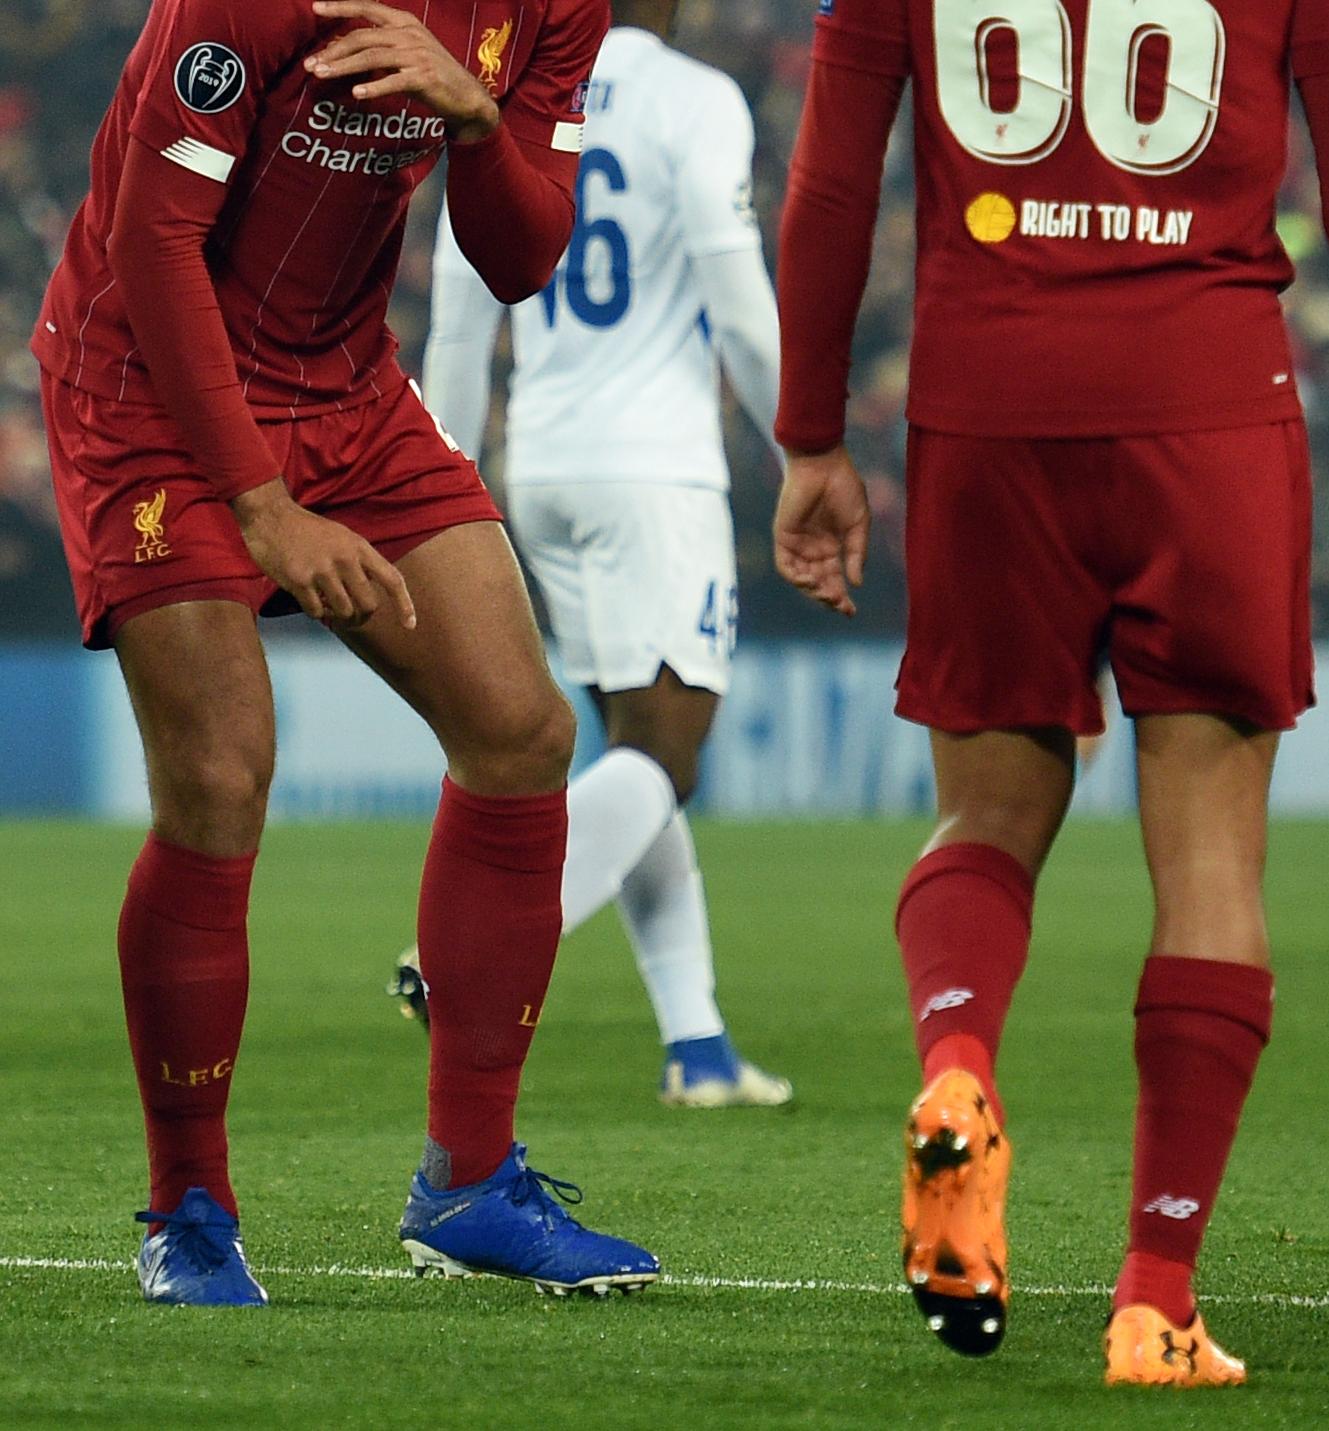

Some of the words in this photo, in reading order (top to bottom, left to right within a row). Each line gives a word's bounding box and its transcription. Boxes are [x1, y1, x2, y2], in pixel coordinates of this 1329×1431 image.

[1020, 199, 1092, 239] RIGHT
[1096, 203, 1131, 241] TO
[1135, 206, 1193, 245] PLAY
